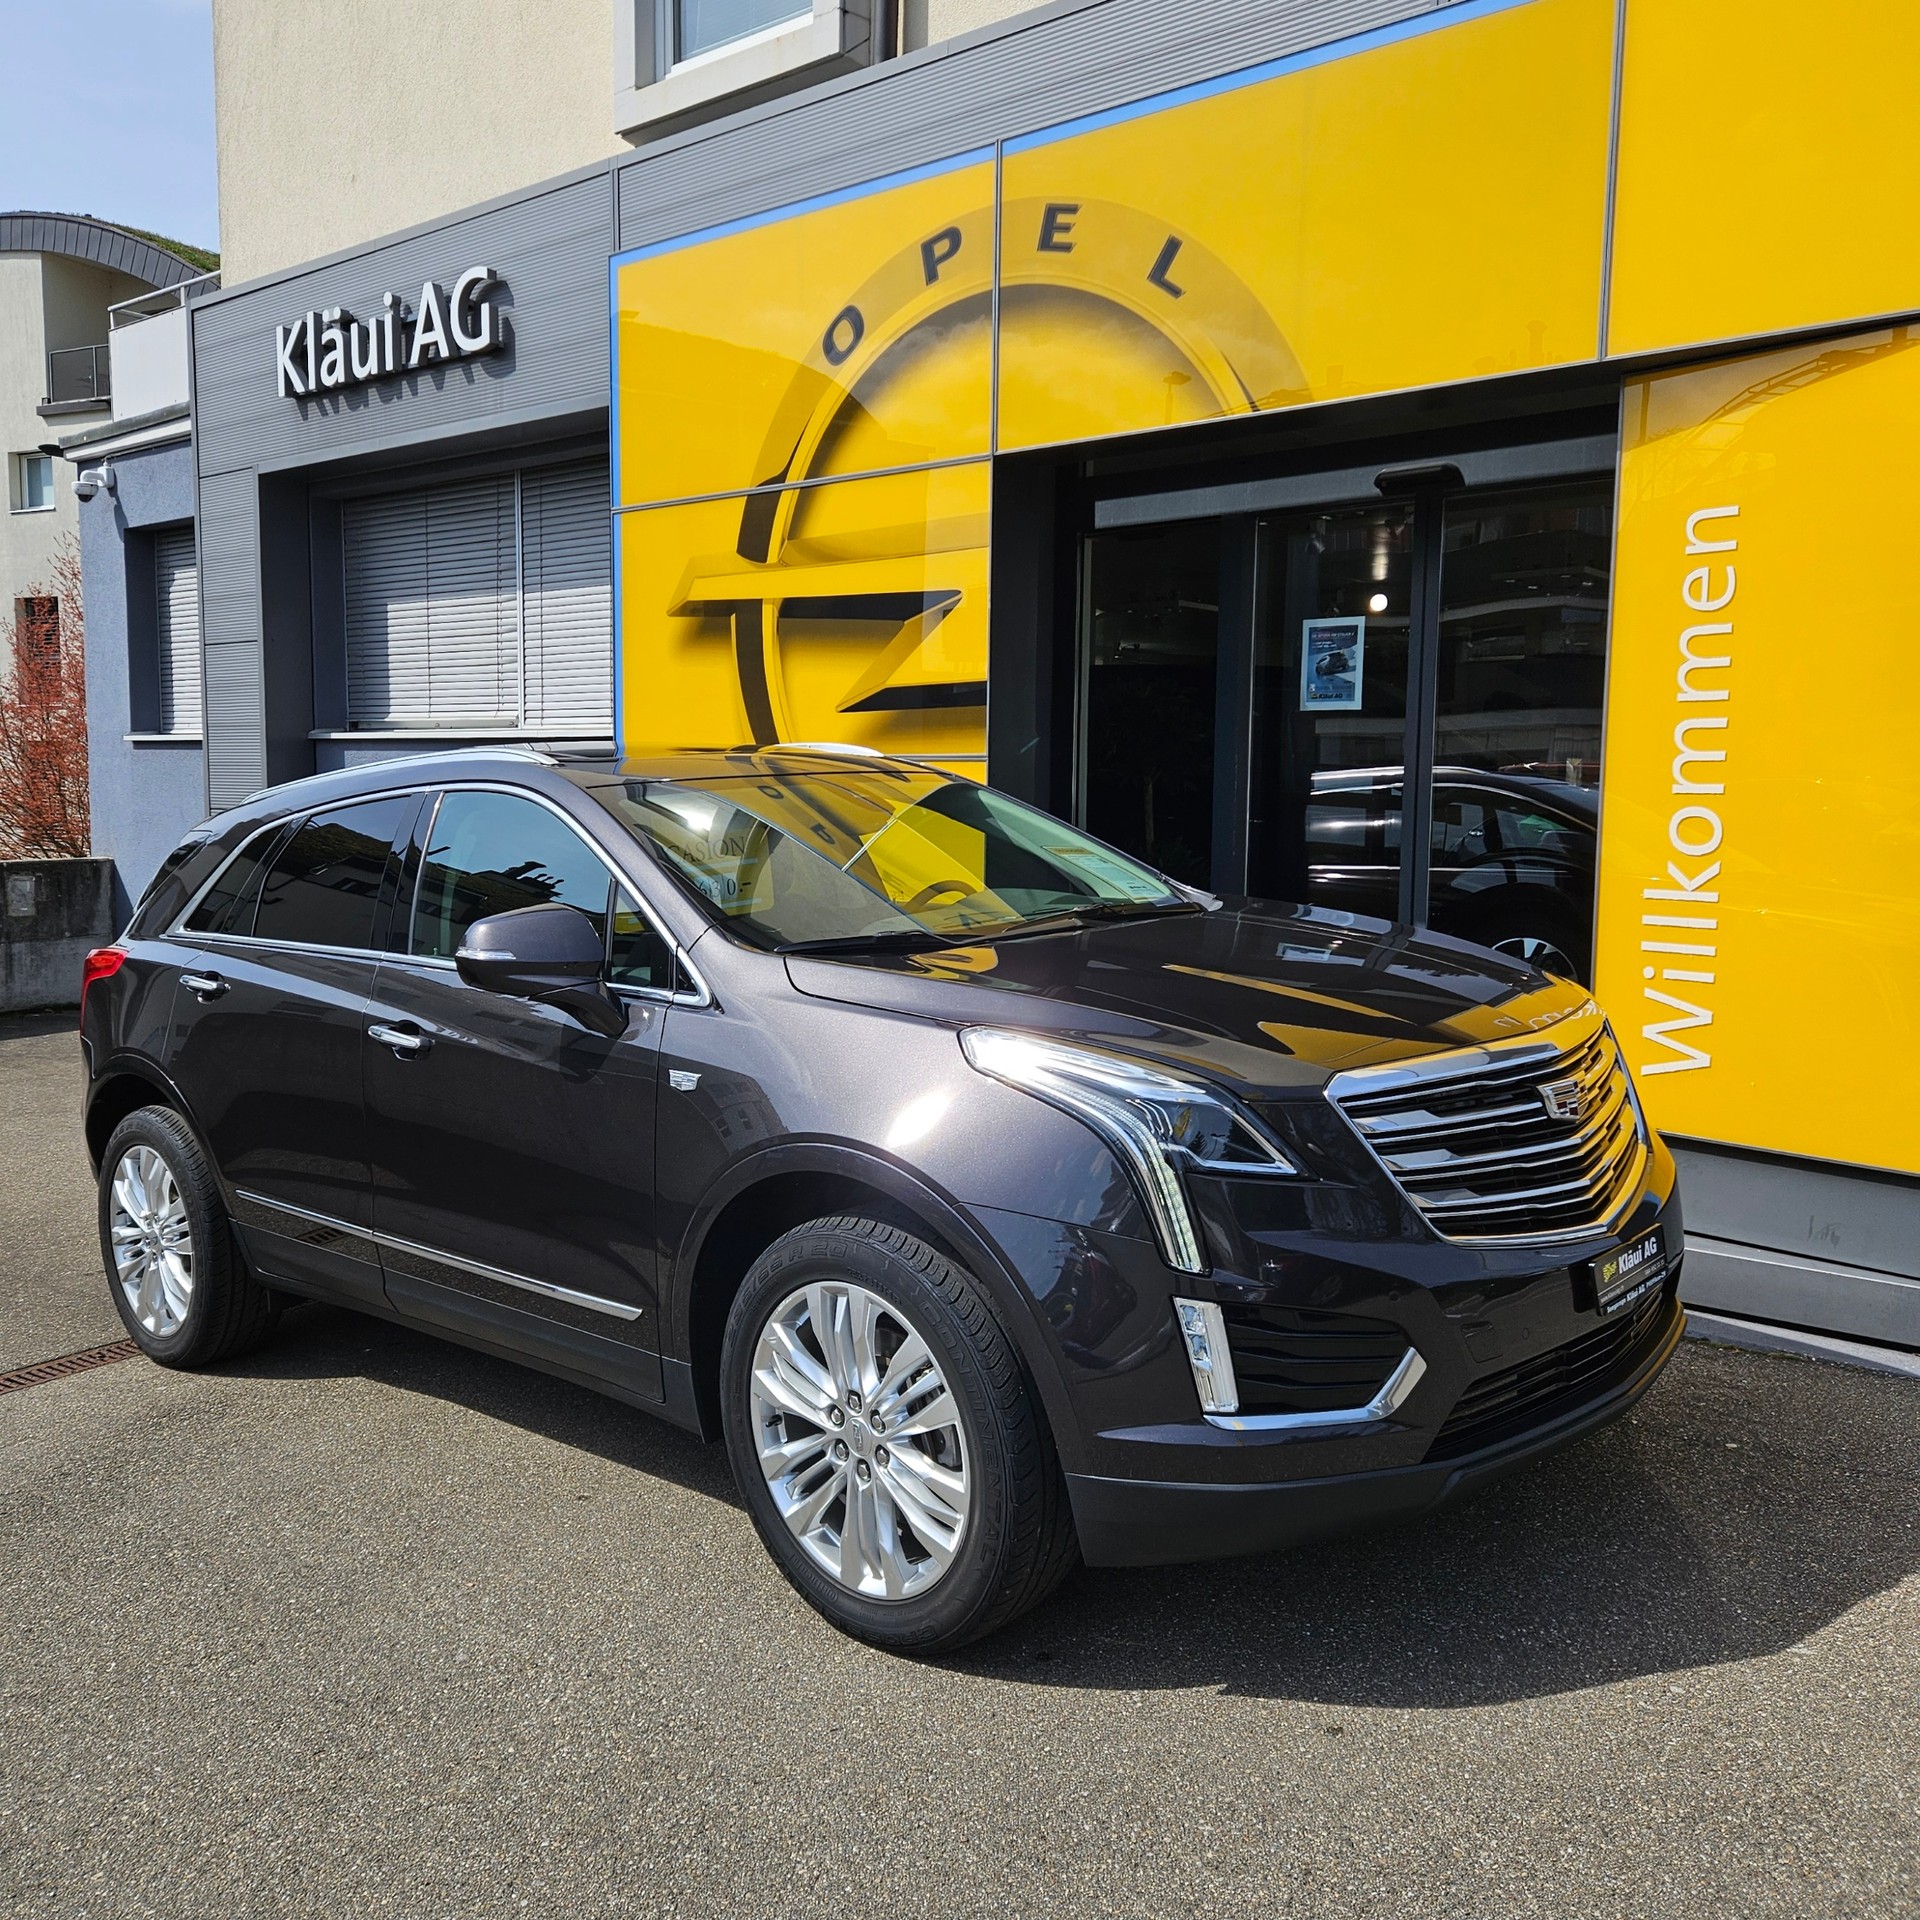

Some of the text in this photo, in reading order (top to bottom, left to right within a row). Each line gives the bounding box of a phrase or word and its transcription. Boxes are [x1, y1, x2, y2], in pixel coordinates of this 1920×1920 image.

[275, 266, 503, 398] Kläui AG
[822, 203, 1186, 366] OPEL
[1641, 505, 1740, 1076] Willkommen
[1618, 1245, 1642, 1274] Kläui
[1644, 1237, 1657, 1258] AG
[917, 1303, 1003, 1563] CONTINENTAL
